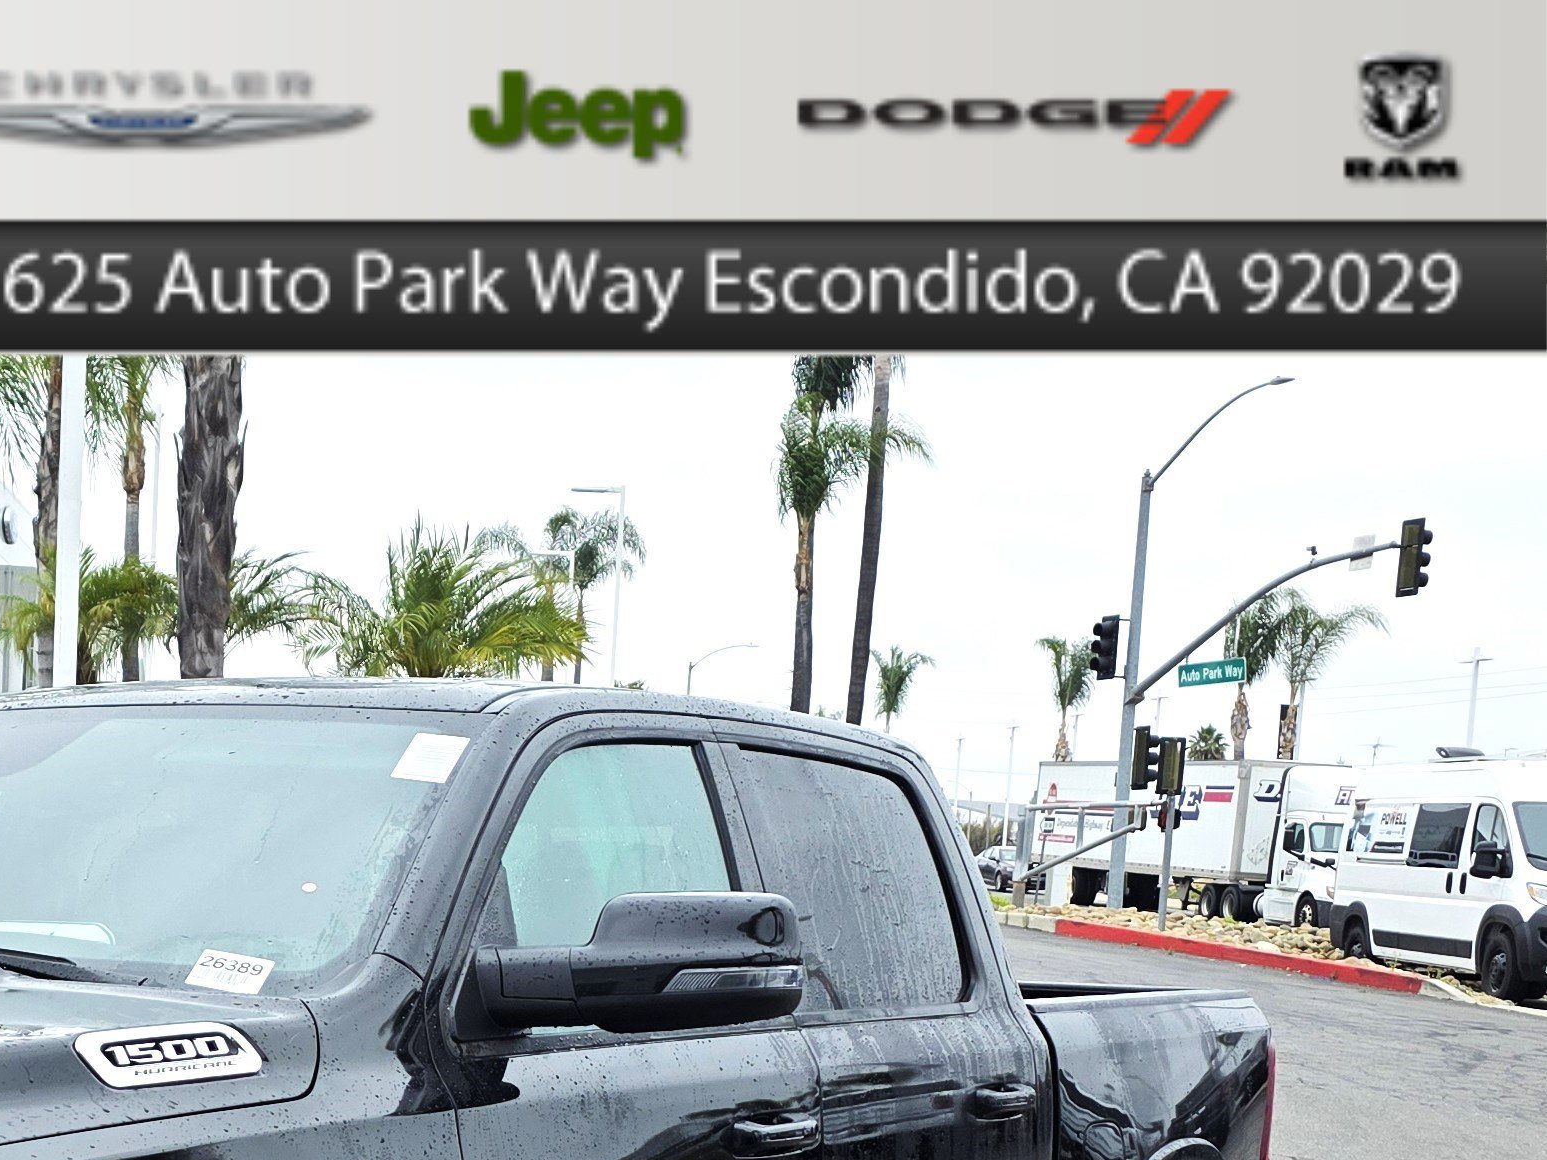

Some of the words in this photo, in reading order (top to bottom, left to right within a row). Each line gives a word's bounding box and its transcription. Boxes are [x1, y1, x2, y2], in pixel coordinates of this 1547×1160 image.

[1180, 668, 1201, 683] Auto
[1202, 665, 1223, 680] Park
[1224, 664, 1243, 680] Way
[1380, 812, 1407, 826] POWELL
[200, 954, 264, 977] 26389
[104, 1034, 231, 1066] 1500
[134, 1059, 239, 1076] HURRICANE
